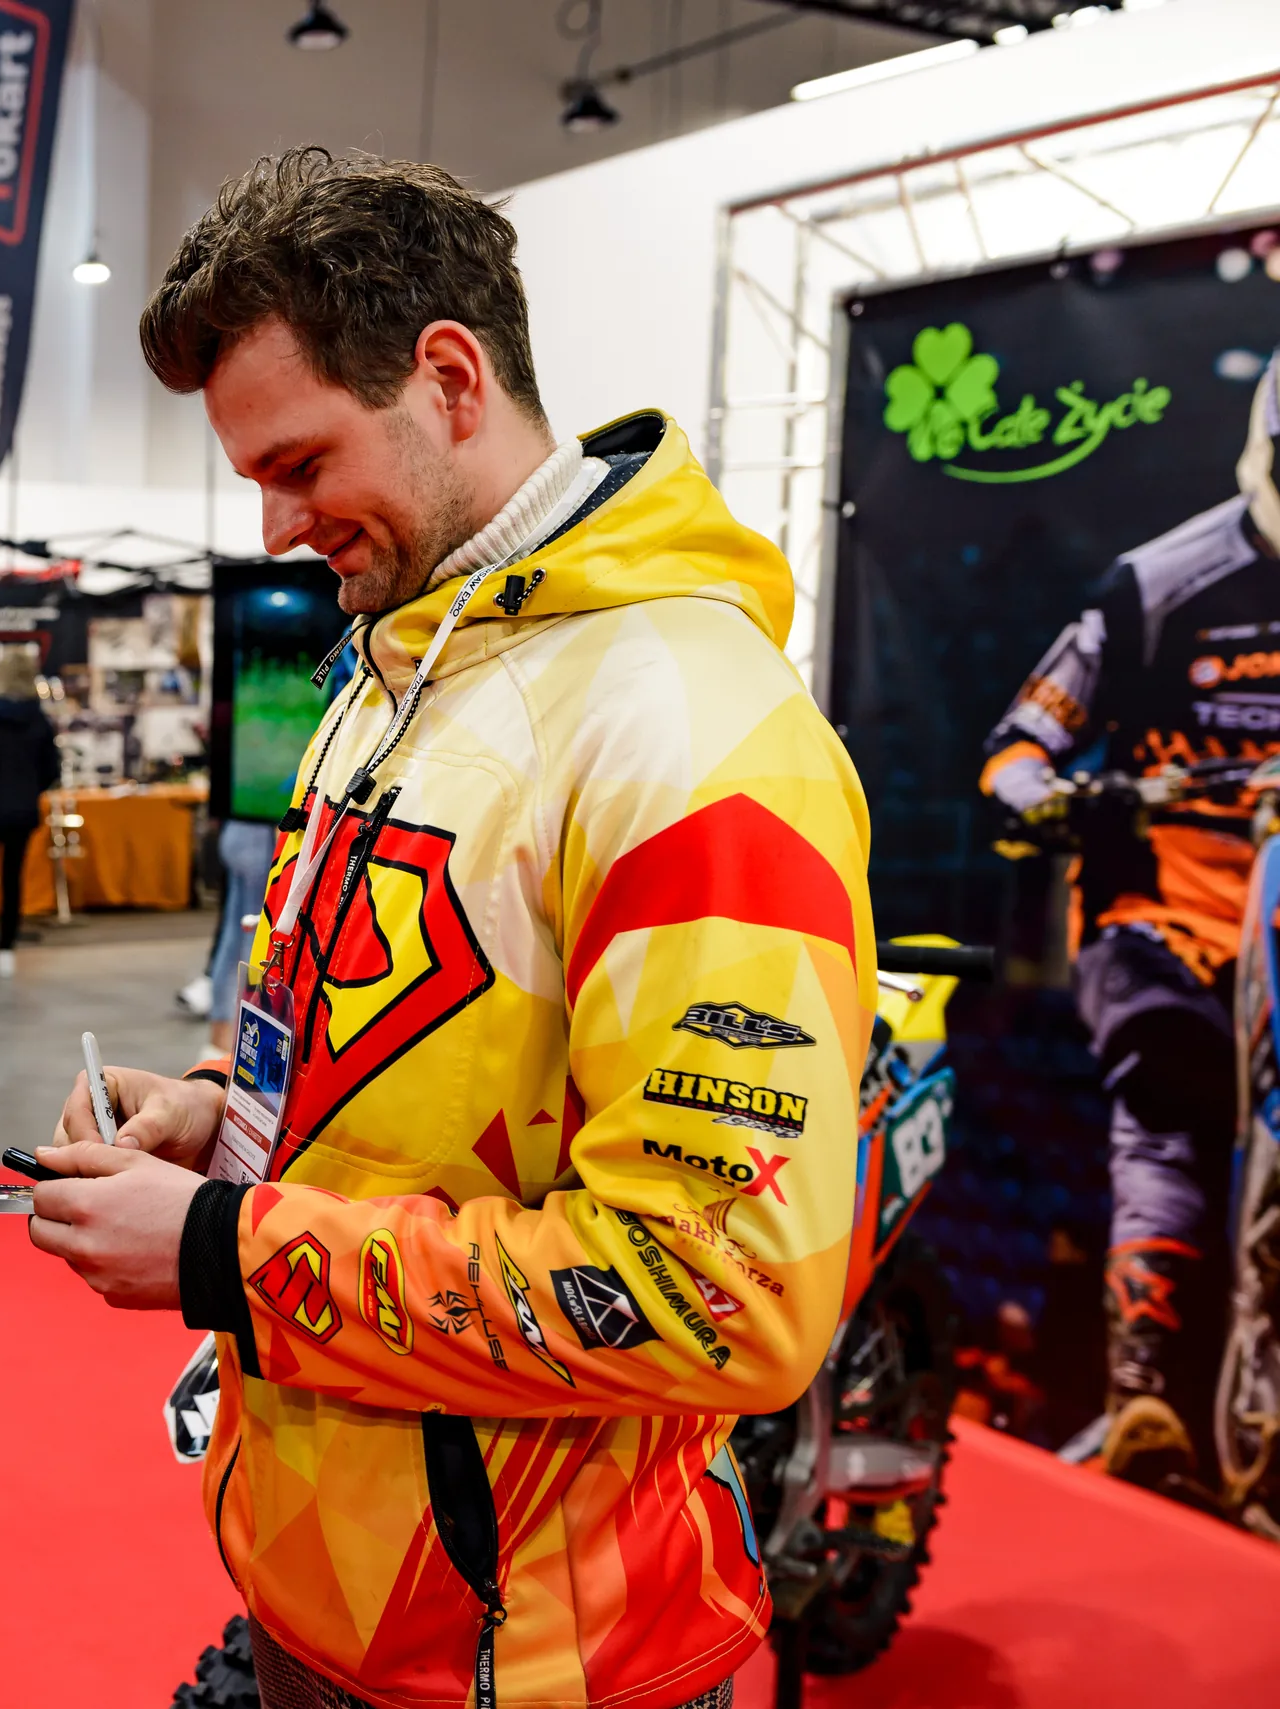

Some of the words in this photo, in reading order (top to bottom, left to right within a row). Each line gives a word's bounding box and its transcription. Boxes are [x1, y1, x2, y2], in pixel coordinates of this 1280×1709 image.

[452, 591, 471, 617] EXPO
[315, 663, 329, 683] PILE
[410, 674, 424, 697] PTAK
[342, 855, 358, 892] THERMO
[646, 1069, 806, 1122] HINSON
[615, 1211, 732, 1370] YOSHIMURA
[479, 1648, 491, 1691] THERMO
